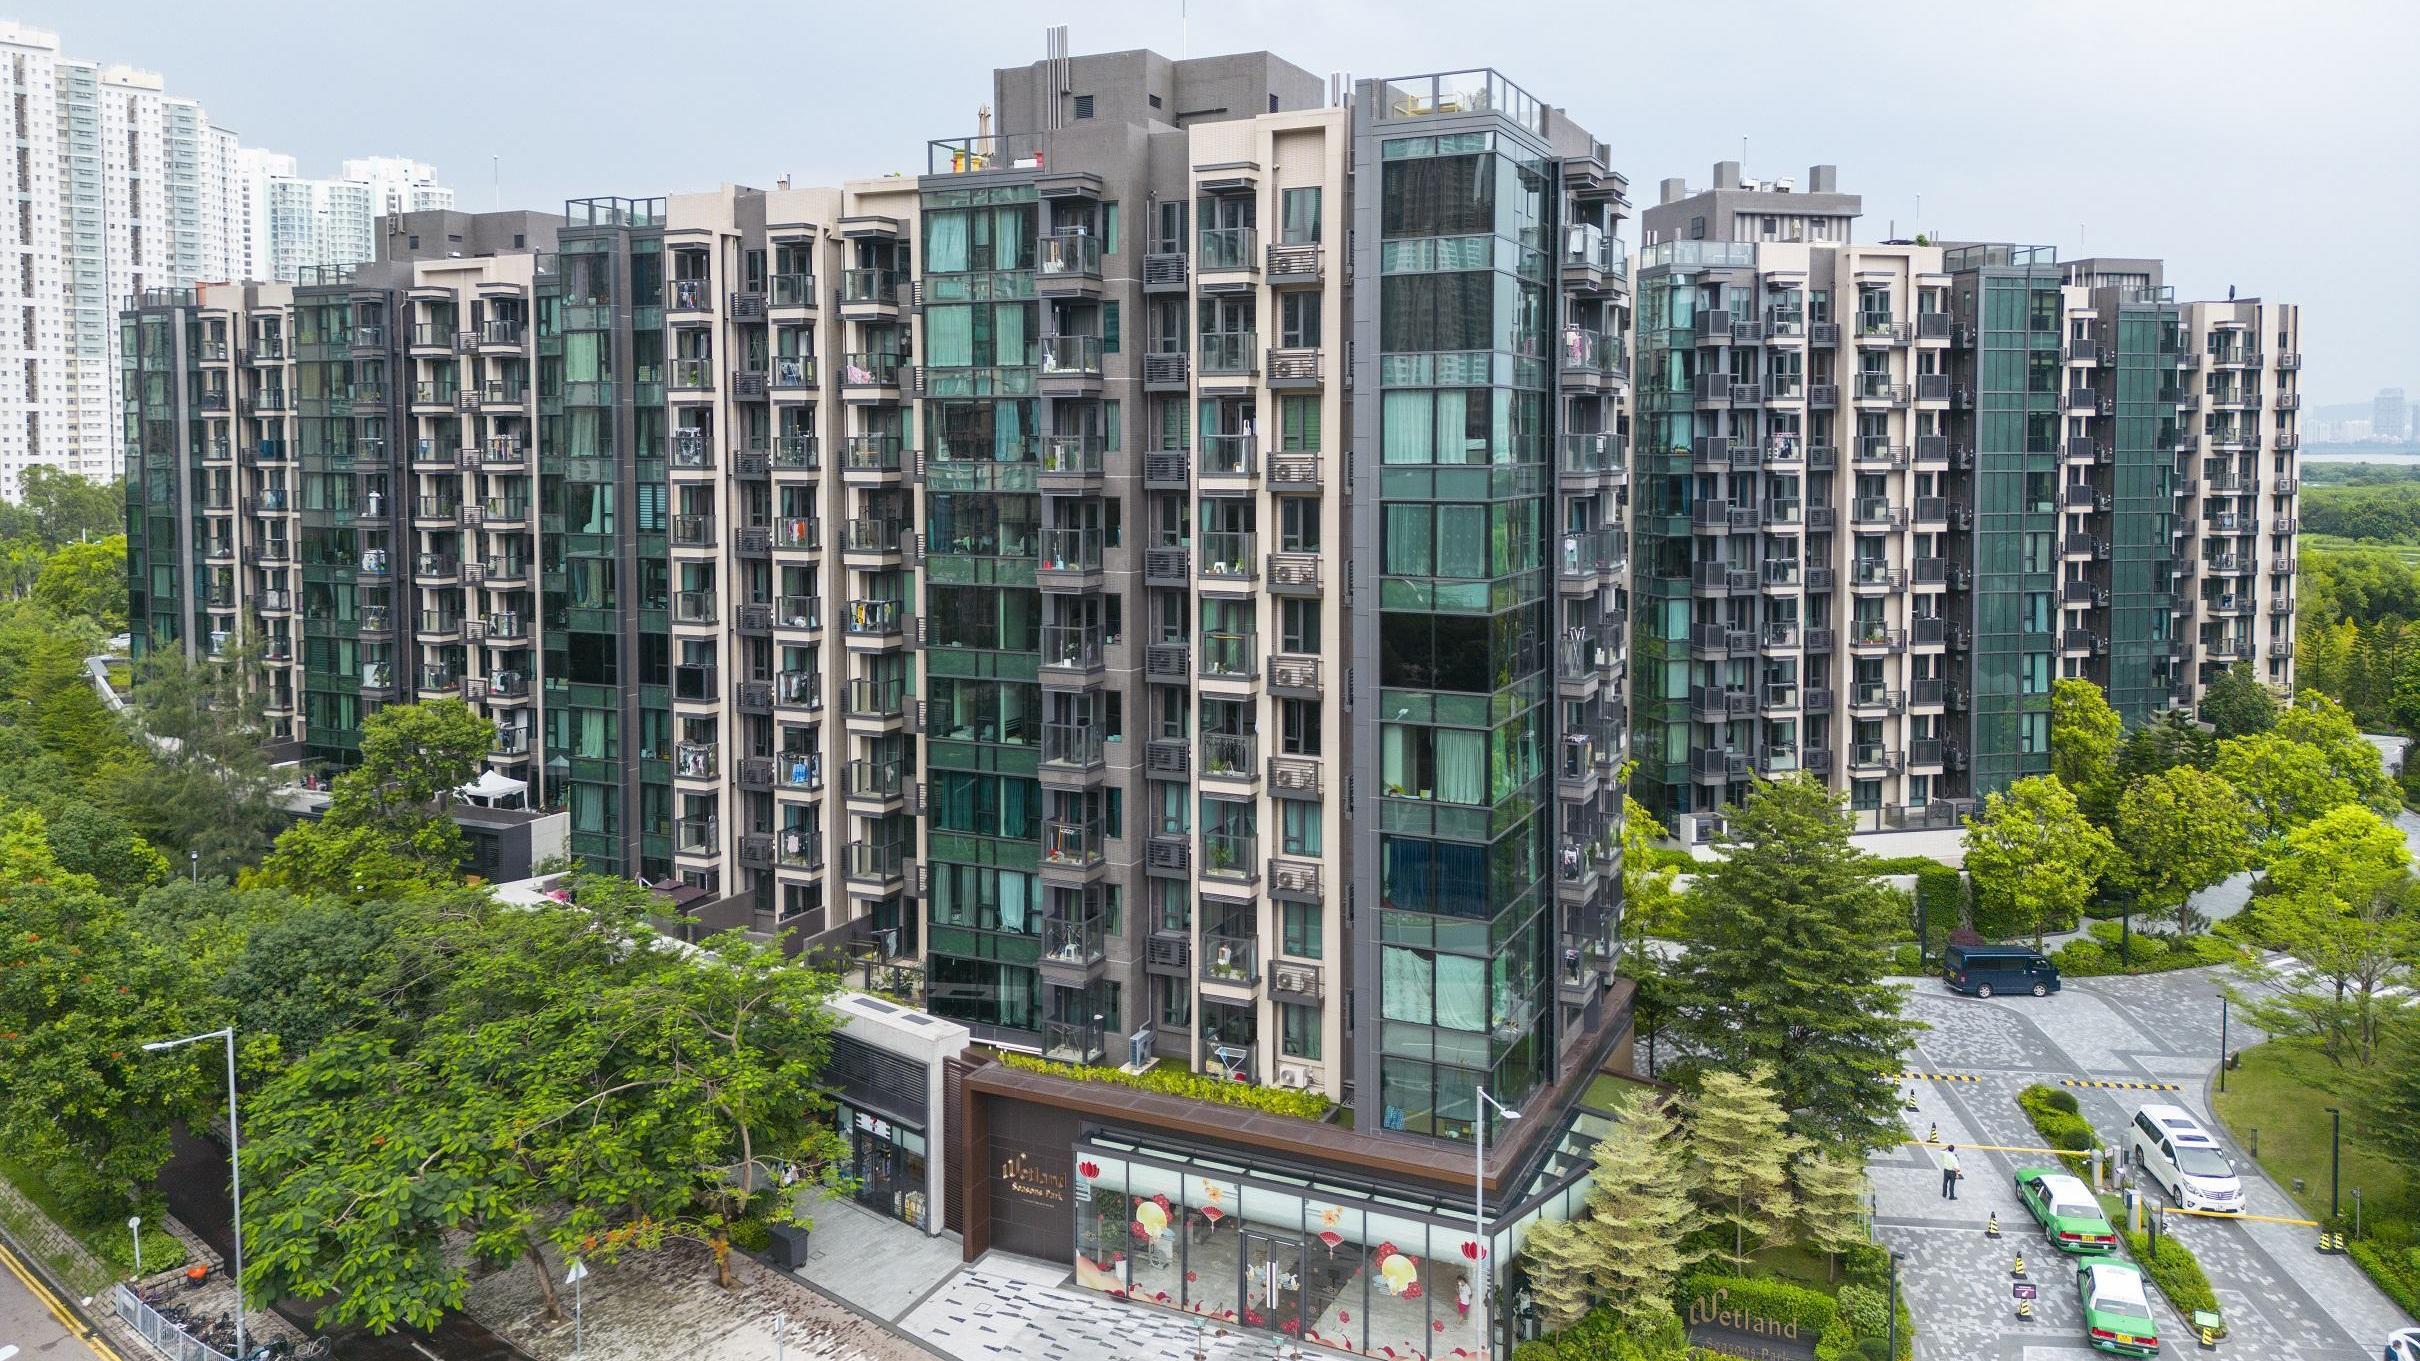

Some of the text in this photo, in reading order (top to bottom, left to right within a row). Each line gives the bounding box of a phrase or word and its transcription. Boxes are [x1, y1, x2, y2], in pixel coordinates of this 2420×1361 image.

[1002, 1153, 1067, 1189] Wetland
[1012, 1181, 1063, 1201] Seasons Park
[1689, 1288, 1797, 1340] Wetland
